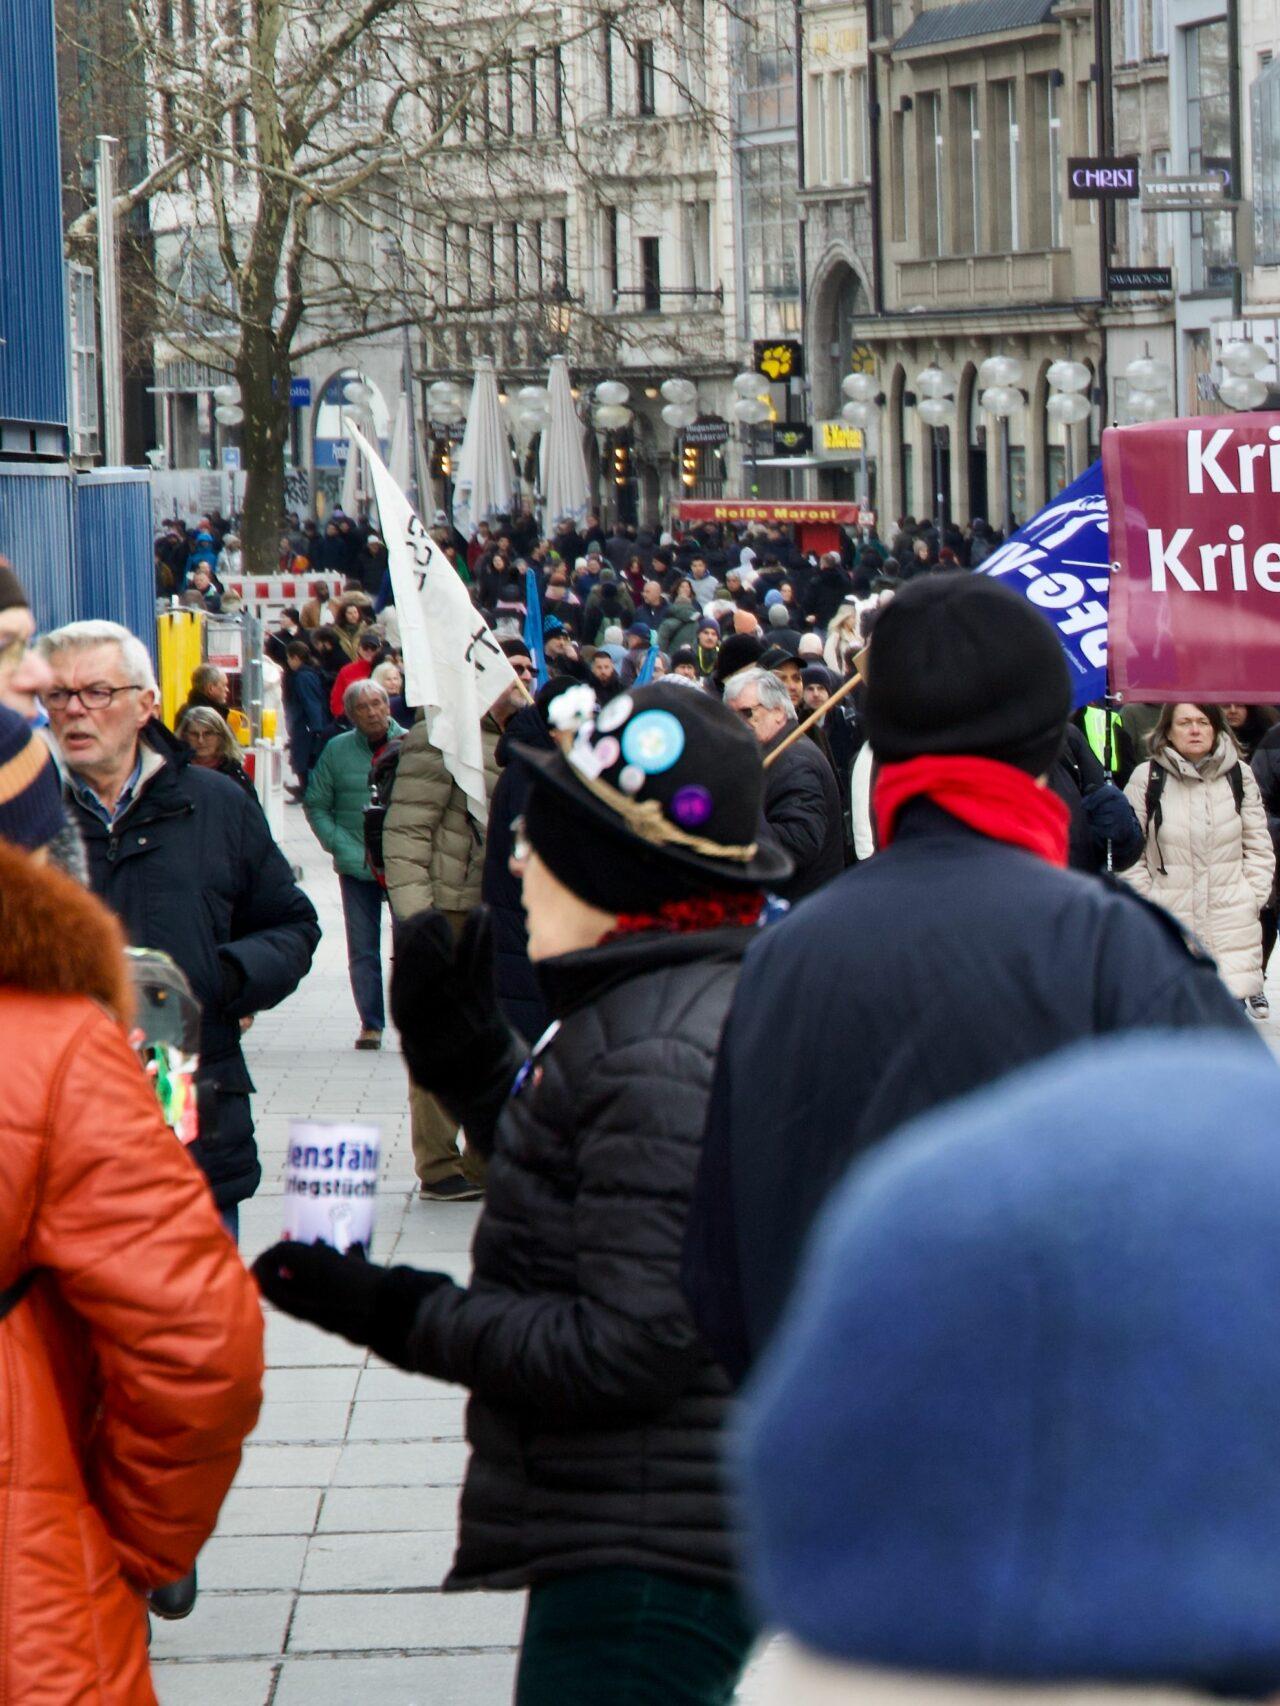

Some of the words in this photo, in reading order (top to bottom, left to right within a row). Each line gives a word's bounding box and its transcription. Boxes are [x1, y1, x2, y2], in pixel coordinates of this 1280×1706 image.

[1072, 168, 1135, 188] CHRIST
[1145, 182, 1221, 194] TRETTER
[1109, 273, 1169, 286] SWAROVSKI
[714, 507, 768, 519] Heiße
[774, 507, 837, 520] Maroni
